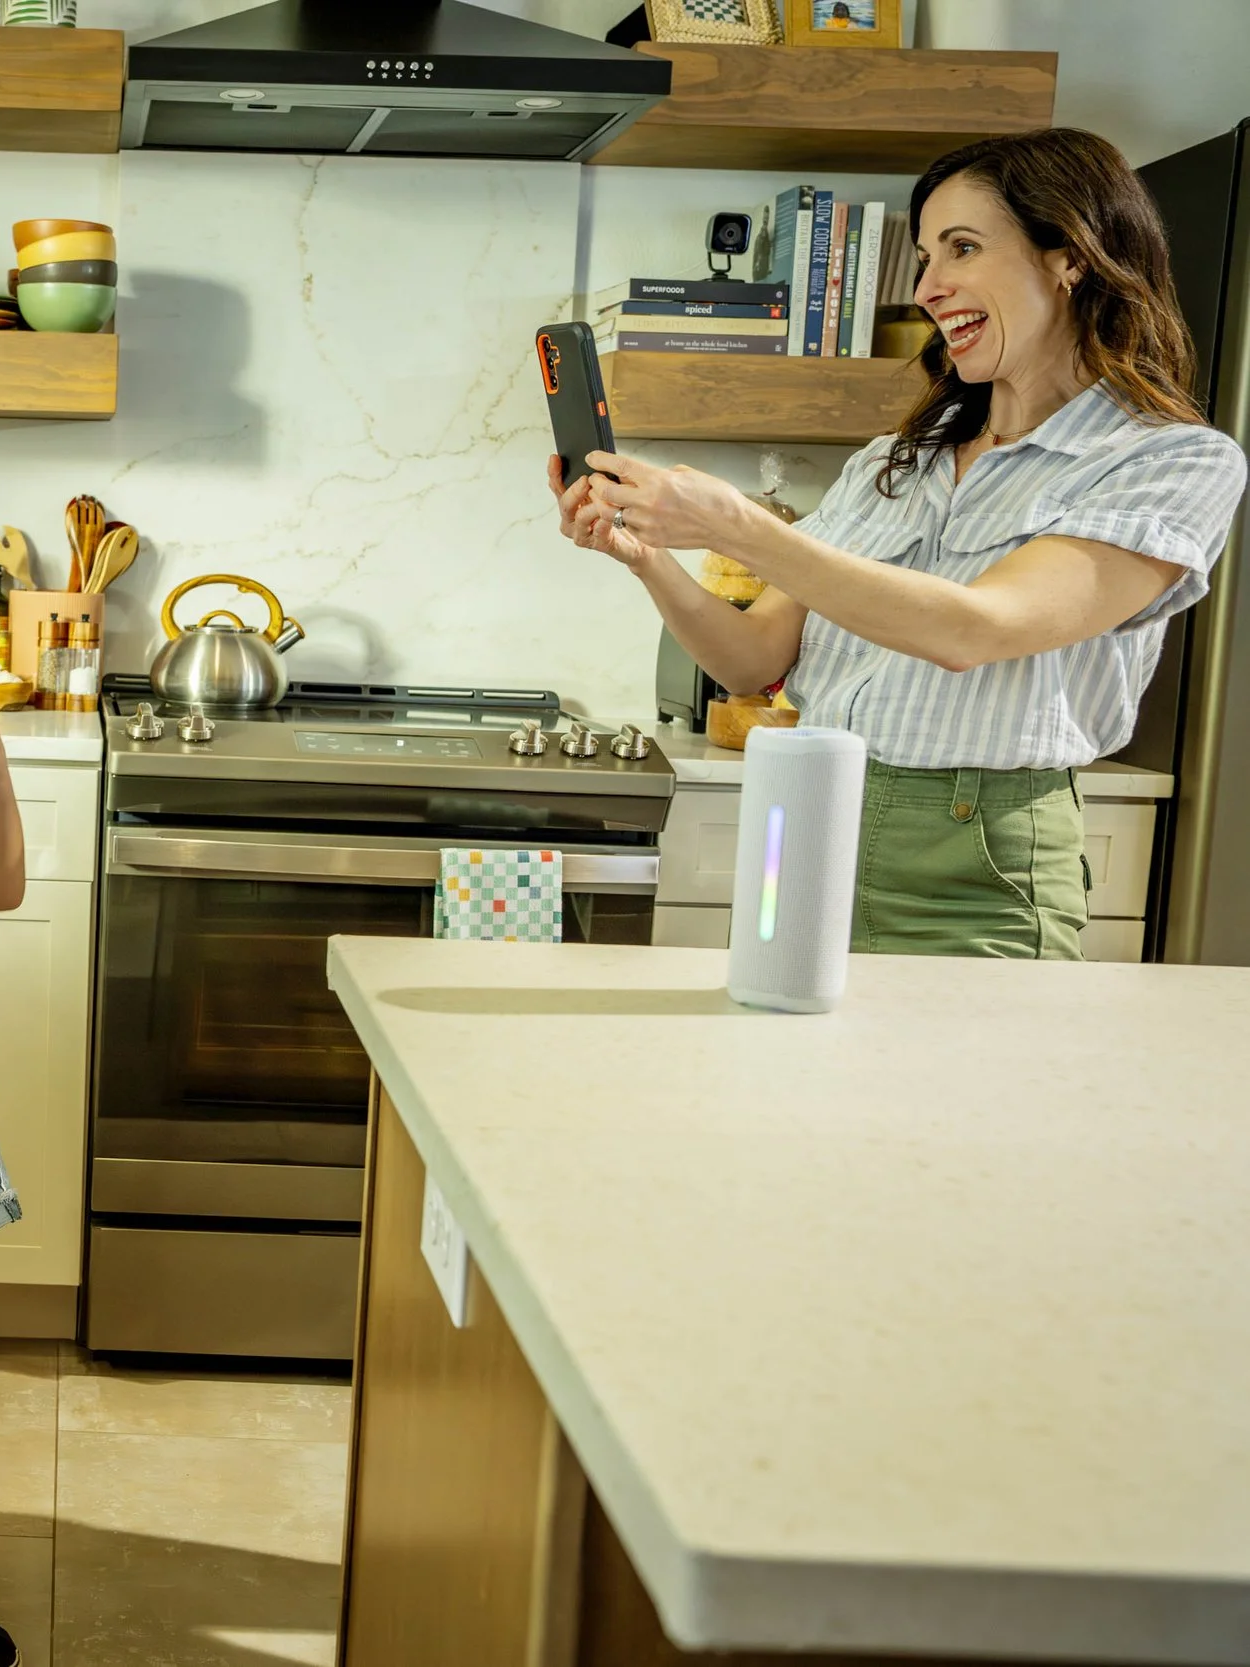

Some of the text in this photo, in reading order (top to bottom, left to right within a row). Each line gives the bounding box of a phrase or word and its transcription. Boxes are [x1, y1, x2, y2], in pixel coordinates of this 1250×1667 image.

[799, 213, 810, 245] BRITAIN
[812, 198, 832, 263] SLOW COOKER
[867, 228, 880, 259] ZERO
[642, 285, 685, 294] SUPERFOODS
[842, 230, 859, 319] THE MEDITERRANEAN TABLE
[863, 261, 876, 300] PROOF
[684, 304, 713, 315] spiced
